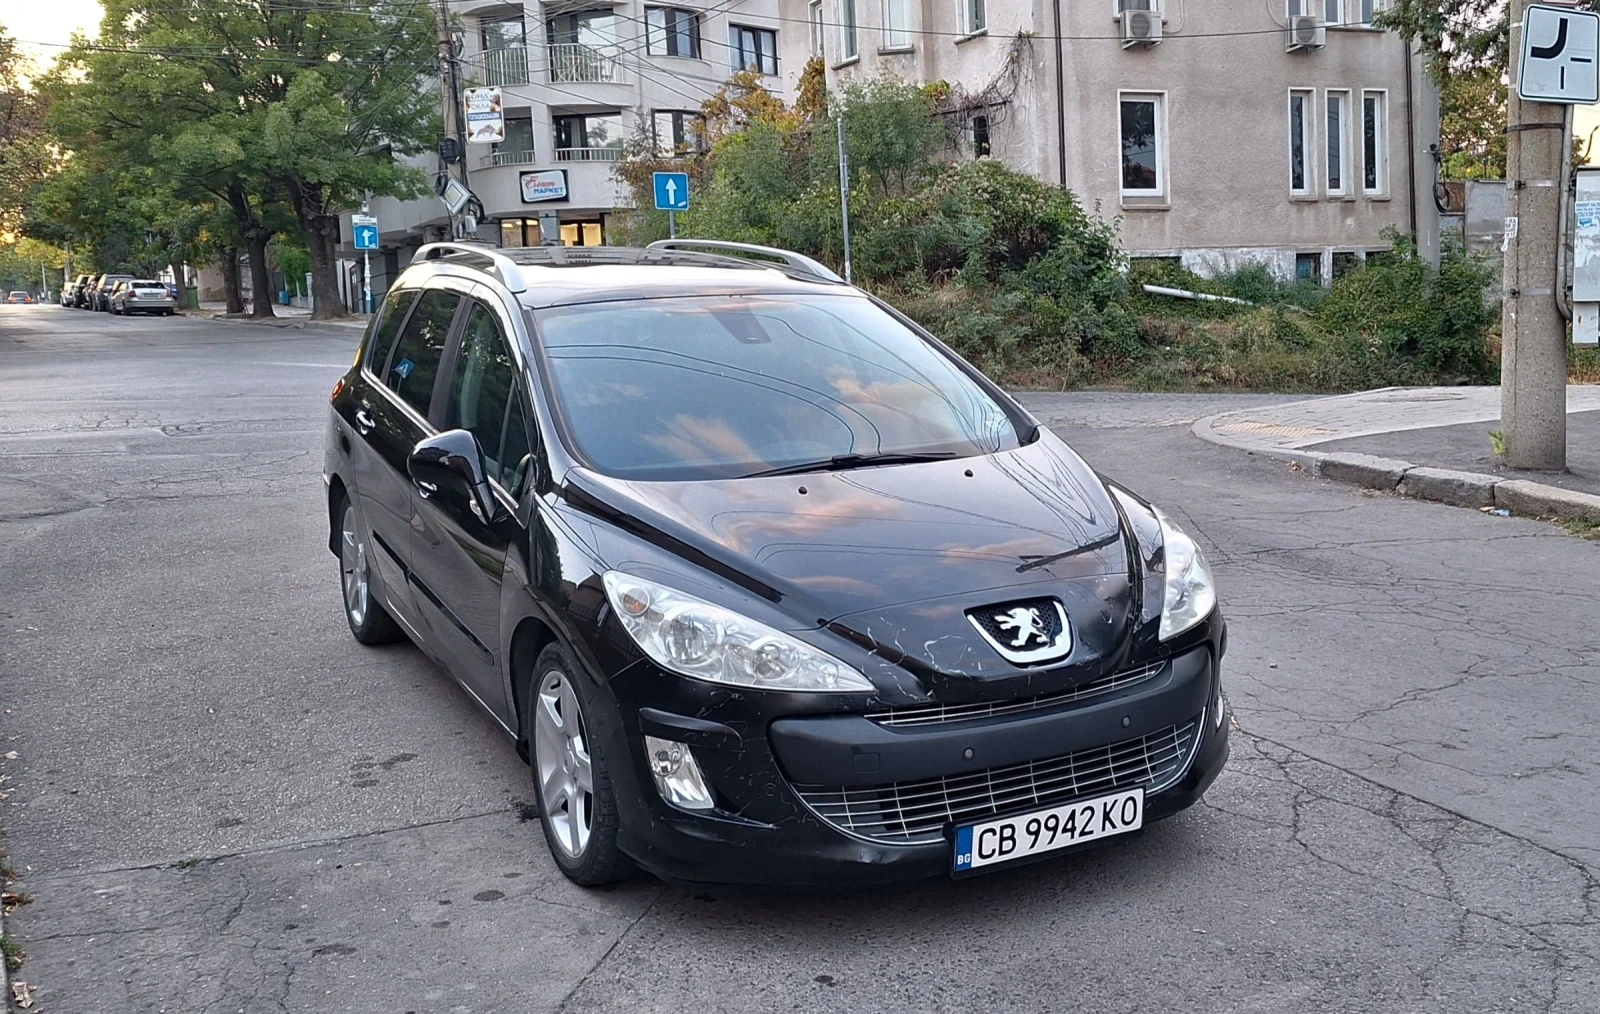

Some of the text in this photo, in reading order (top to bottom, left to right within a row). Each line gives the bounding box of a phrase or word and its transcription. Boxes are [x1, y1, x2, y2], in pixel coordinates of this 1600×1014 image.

[978, 796, 1138, 860] CB 9942 KO
[957, 853, 971, 865] BG
